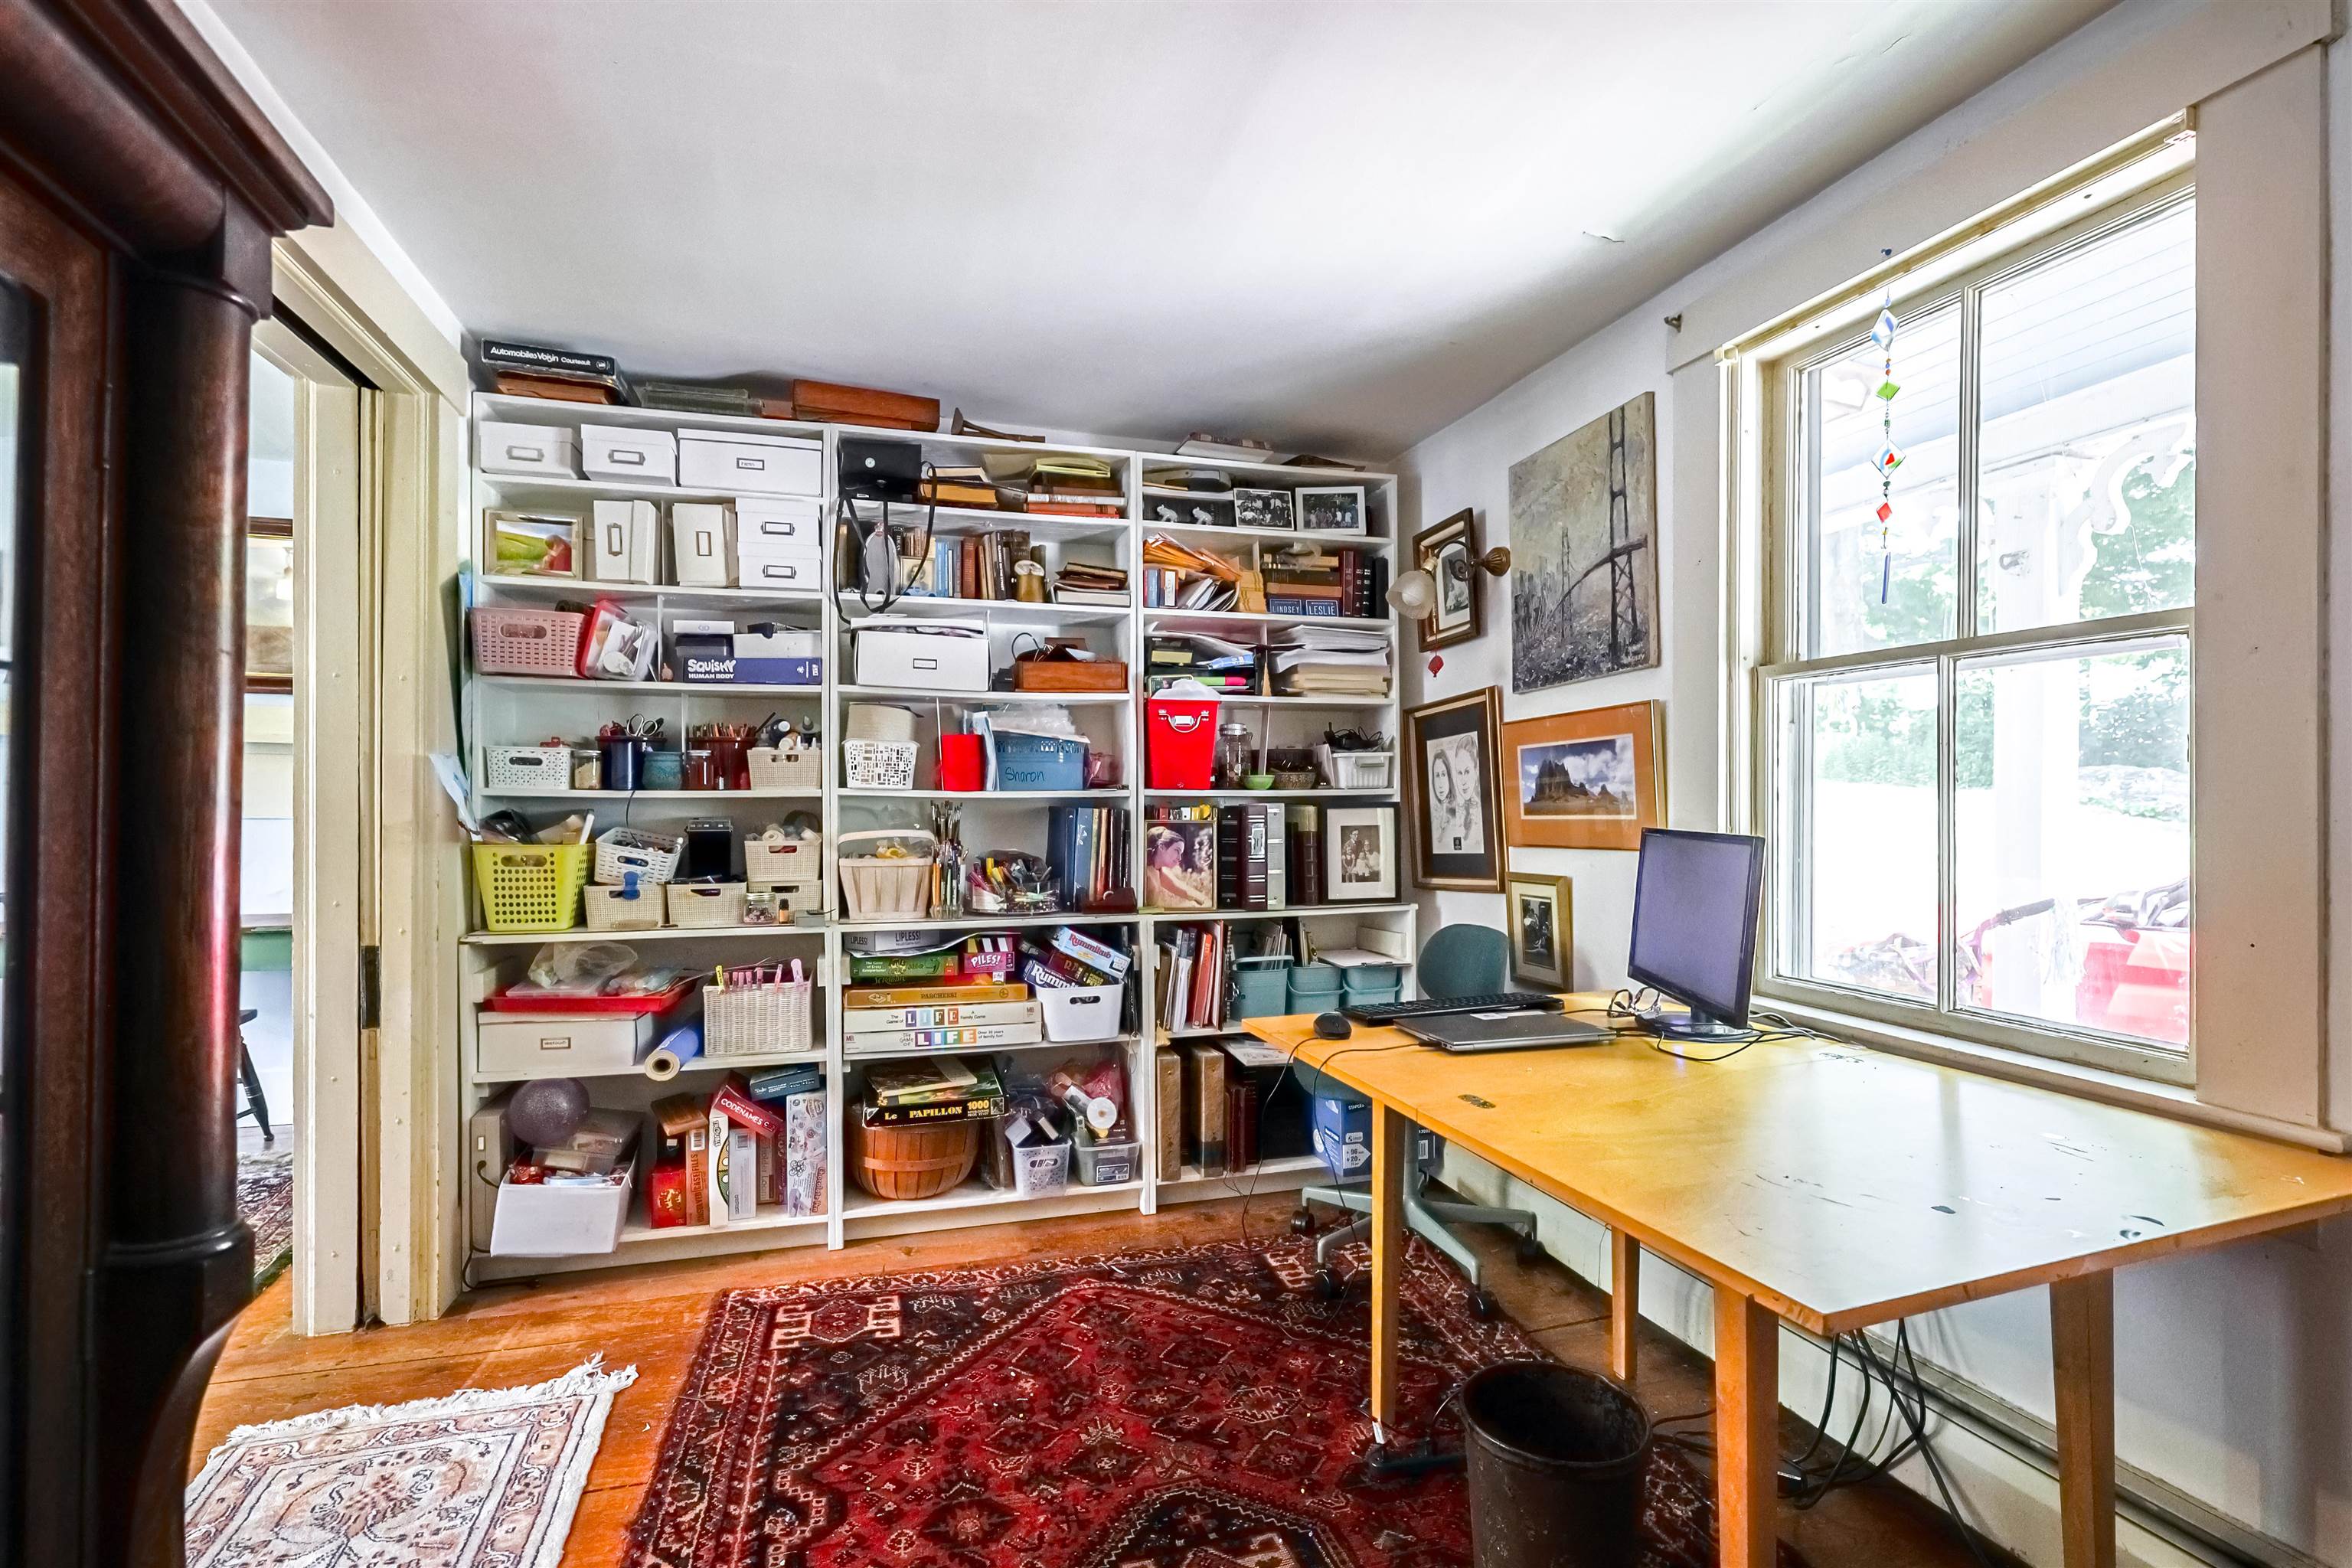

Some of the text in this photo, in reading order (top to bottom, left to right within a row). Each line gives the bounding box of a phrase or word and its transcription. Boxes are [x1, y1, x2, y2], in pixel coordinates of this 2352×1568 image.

[490, 346, 537, 359] Automobiles
[537, 351, 559, 363] Voisin
[1272, 606, 1300, 614] LINDSEY
[1308, 605, 1335, 616] LESLIE
[1004, 766, 1045, 782] Sharon
[1068, 933, 1112, 959] Rummikub
[971, 954, 1001, 968] PILES!
[906, 1009, 958, 1025] LIFE
[916, 1030, 975, 1047] LIFE
[720, 1098, 763, 1125] CODENAMES
[909, 1106, 962, 1119] PAPILLON
[967, 1099, 990, 1110] 1000
[691, 1154, 700, 1171] FILES
[692, 1173, 702, 1191] CASE
[812, 1166, 826, 1213] Chocolate Pen
